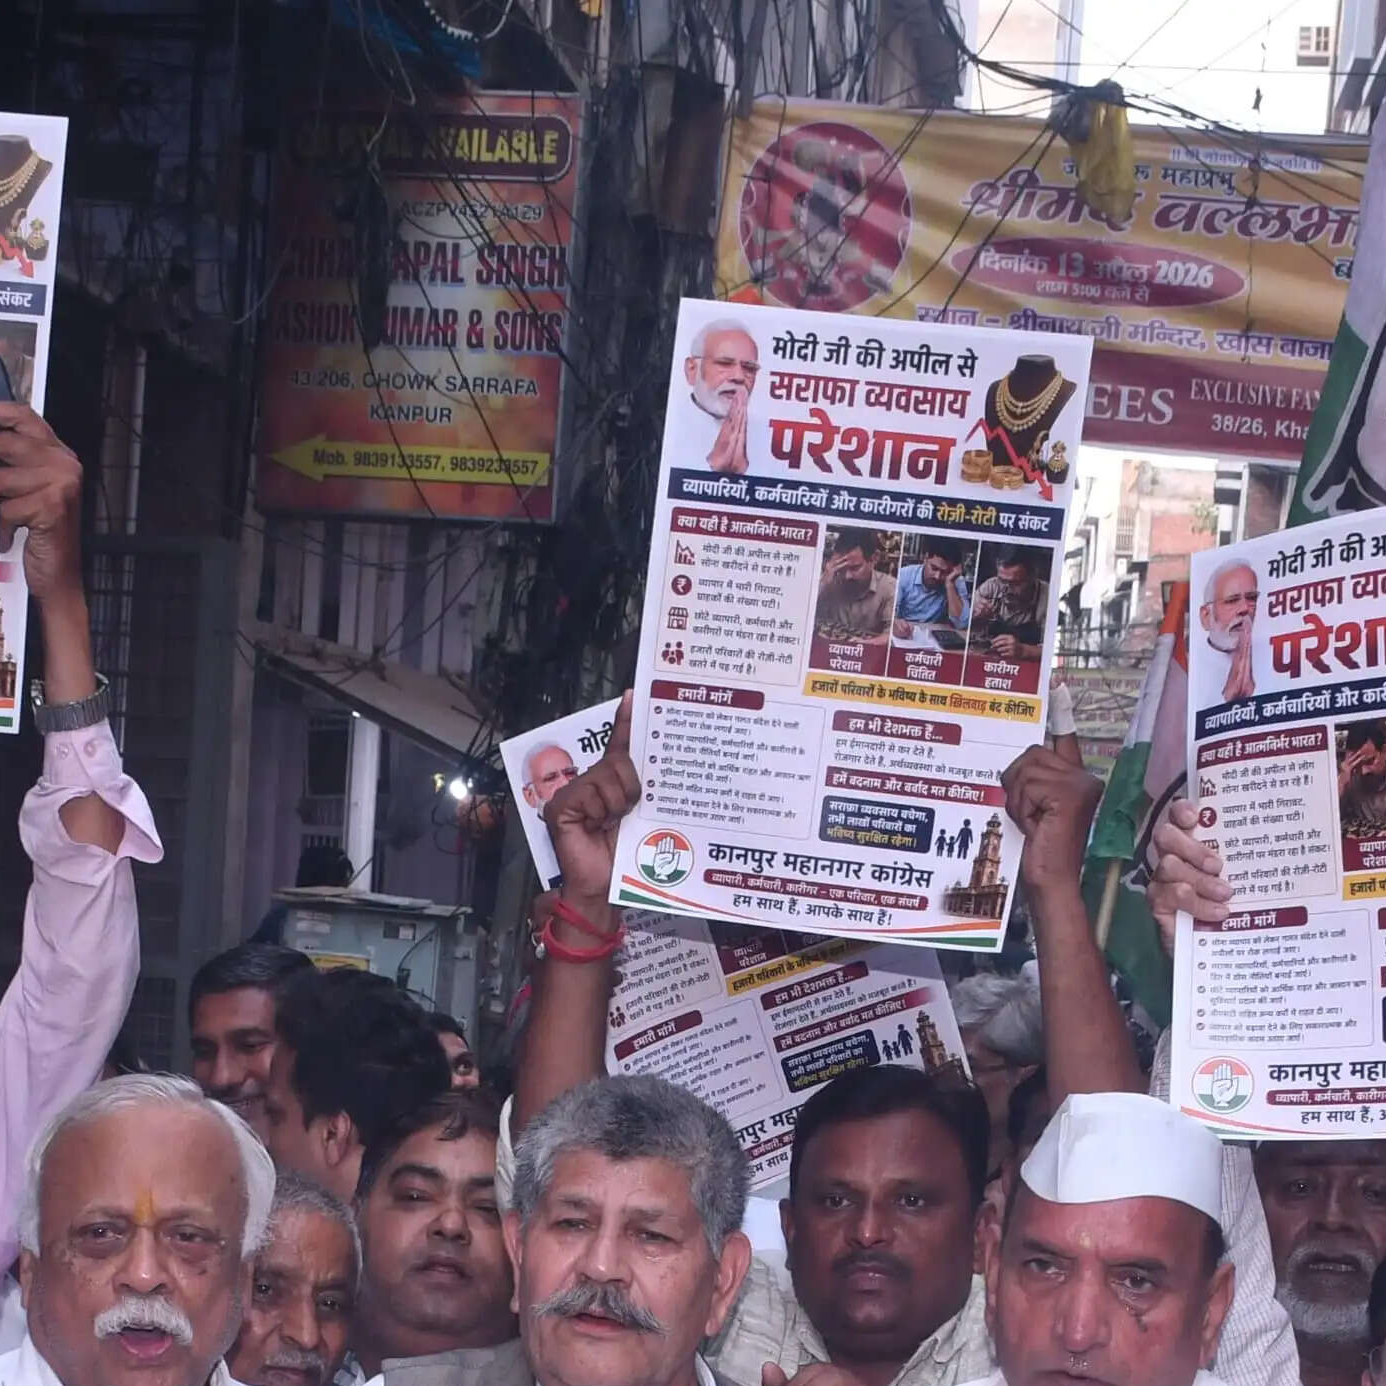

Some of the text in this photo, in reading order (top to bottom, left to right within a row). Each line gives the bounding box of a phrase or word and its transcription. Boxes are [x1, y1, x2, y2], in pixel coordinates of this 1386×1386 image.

[475, 242, 566, 288] SINGH
[978, 248, 1050, 276] दिनांक
[1058, 252, 1085, 278] 13
[1156, 259, 1215, 289] 2026
[379, 305, 459, 348] UMAR
[466, 309, 485, 350] &
[494, 310, 563, 353] SONS
[1280, 337, 1334, 361] बाजा
[772, 330, 979, 379] मोदी जी की अपील से
[363, 371, 438, 392] CHOWK
[445, 375, 539, 397] SARRAFA
[769, 370, 972, 420] सराफा व्यवसाय
[1189, 378, 1287, 408] EXCLUSIVE
[370, 404, 453, 424] KANPUR
[1211, 413, 1268, 436] 38/26,
[768, 407, 958, 486] परेशान
[1267, 544, 1307, 579] मोदी
[1309, 538, 1335, 569] जी
[1338, 532, 1367, 564] की
[1267, 575, 1346, 618] सराफा
[1267, 1062, 1343, 1088] कानपुर
